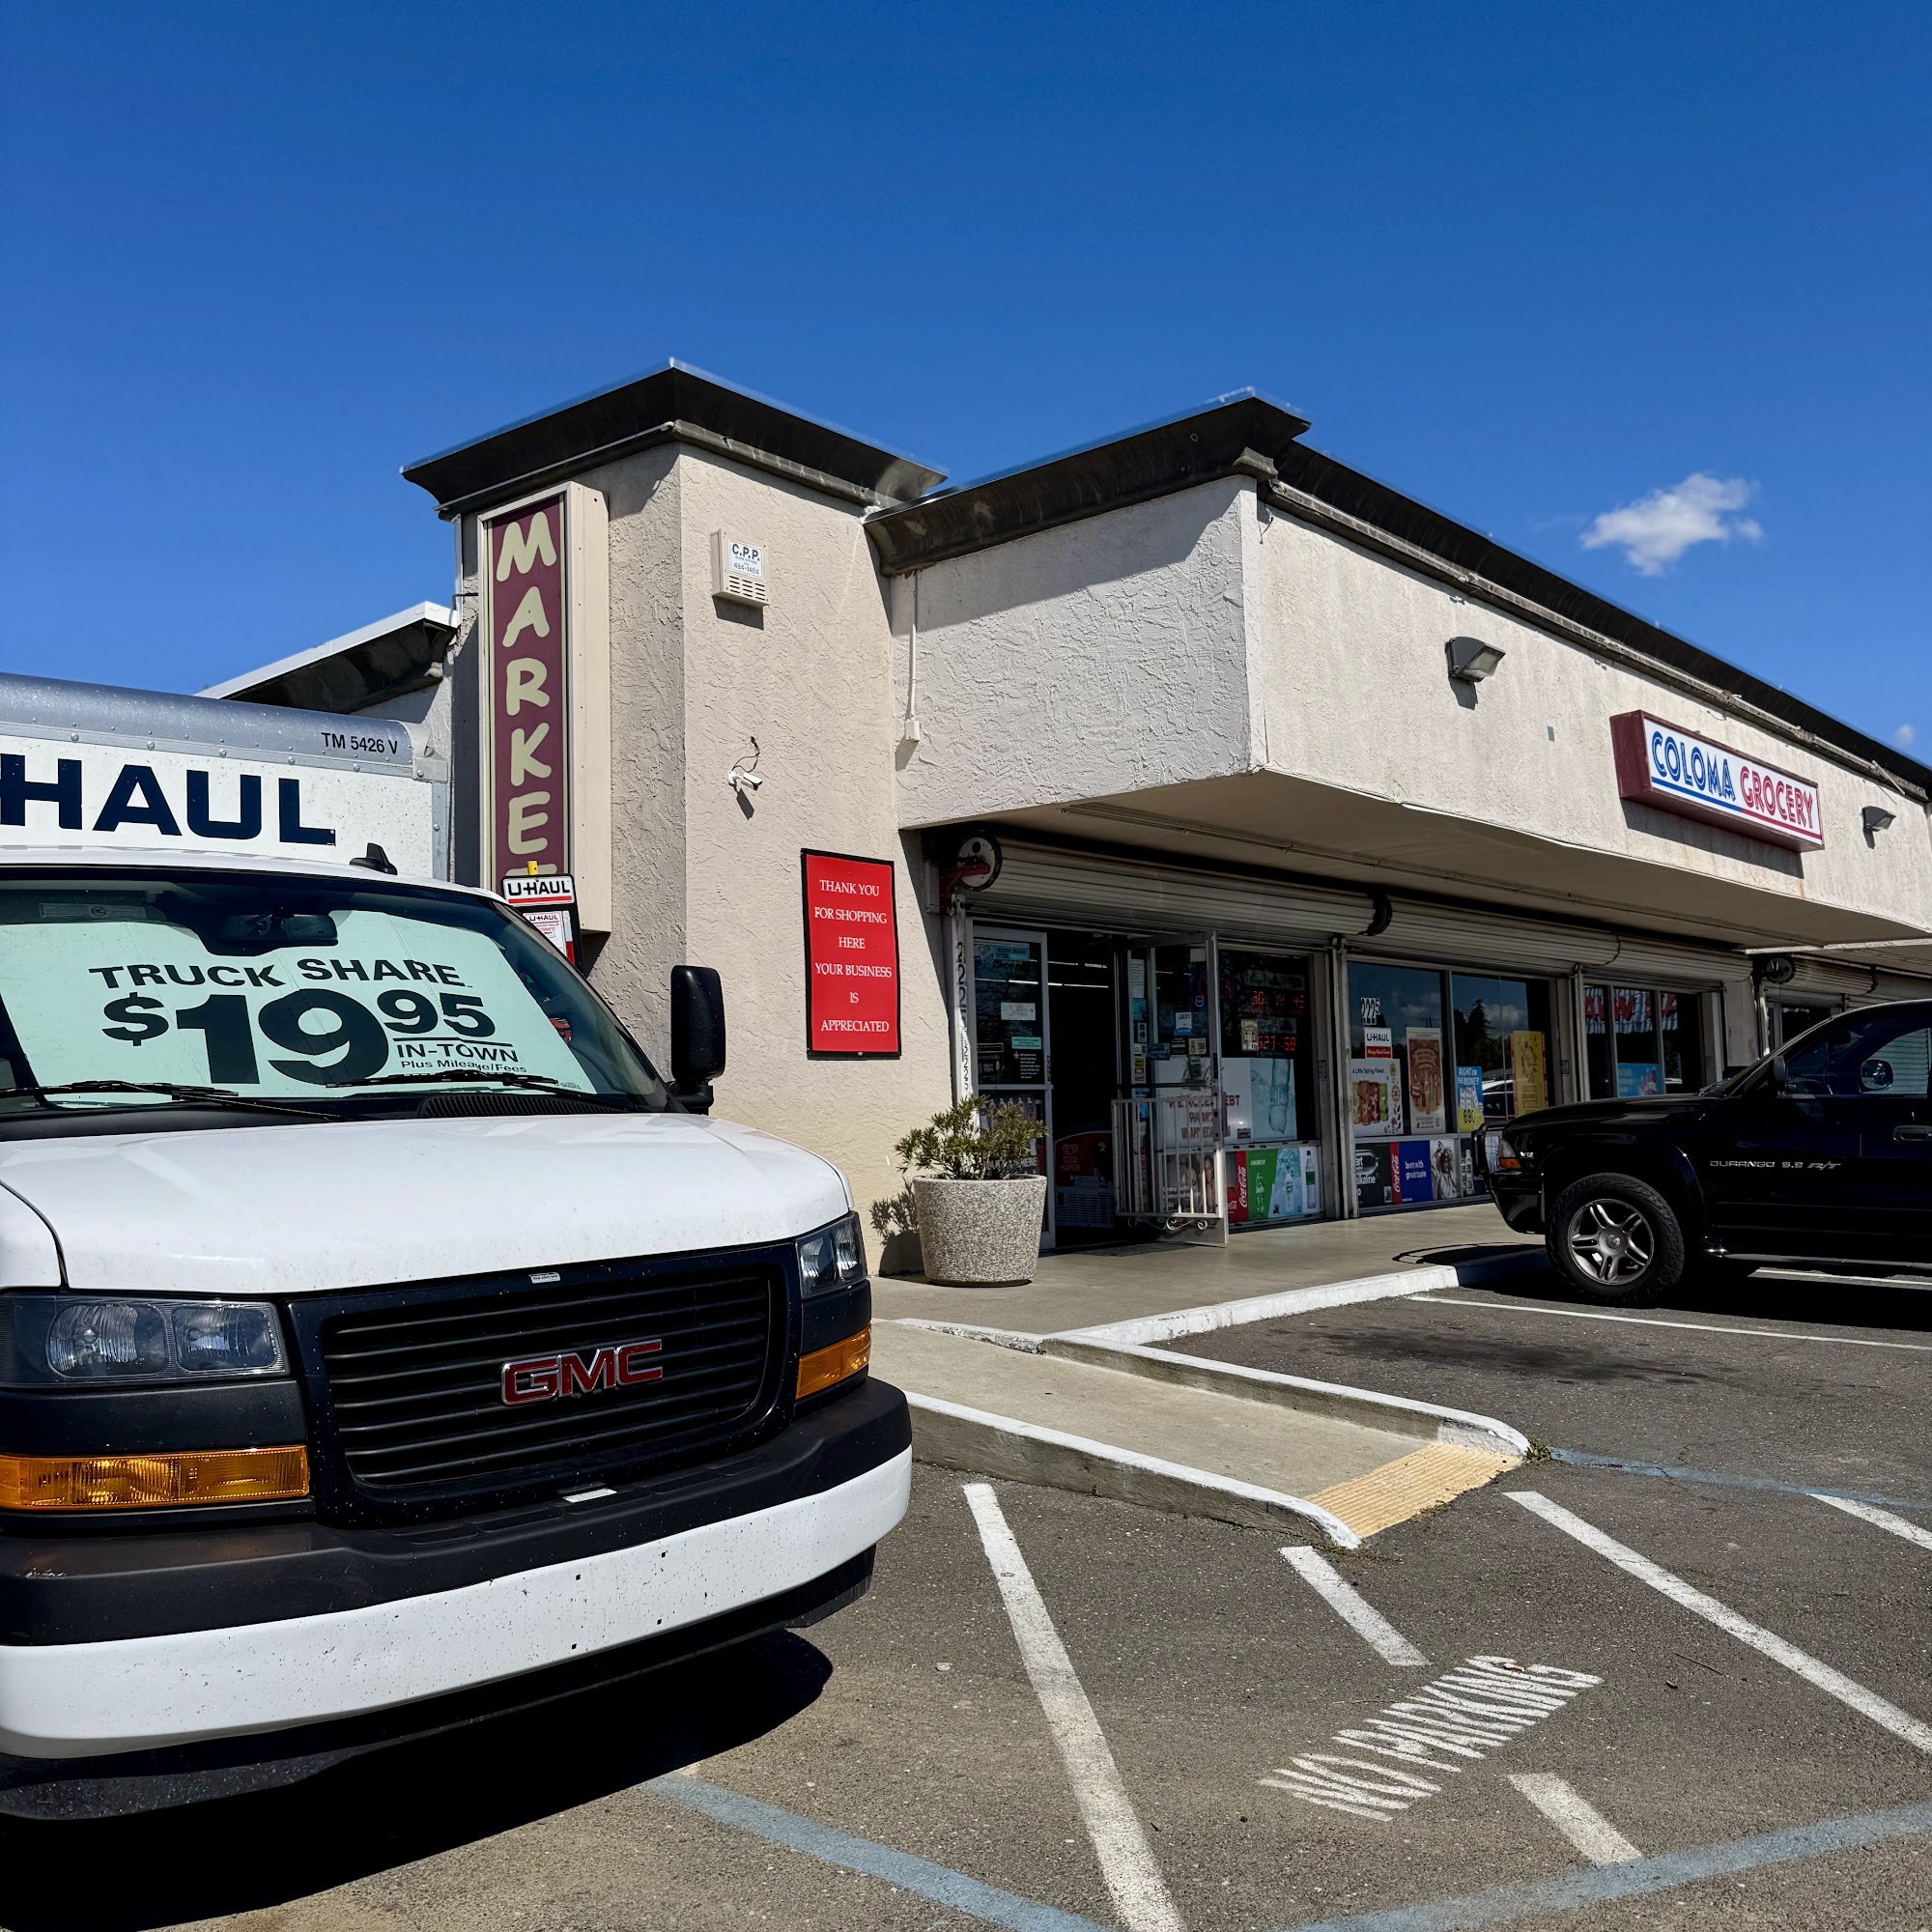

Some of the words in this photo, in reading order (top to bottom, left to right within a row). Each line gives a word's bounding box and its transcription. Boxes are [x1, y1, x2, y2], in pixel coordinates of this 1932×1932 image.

[732, 543, 760, 562] C.P.P.
[321, 732, 346, 749] TM
[351, 736, 384, 753] 5426
[387, 740, 398, 754] V
[1652, 731, 1737, 802] COLOMA
[1740, 766, 1813, 829] GROCERY
[507, 880, 570, 896] U-HAUL
[820, 880, 857, 895] THANK
[859, 884, 879, 896] YOU
[814, 907, 835, 920] FOR
[836, 909, 887, 923] SHOPPING
[838, 937, 865, 950] HERE
[88, 964, 286, 990] TRUCK
[297, 958, 466, 987] SHARE
[815, 963, 843, 976] YOUR
[845, 965, 892, 978] BUSINESS
[850, 992, 859, 1004] IS
[821, 1020, 889, 1033] APPRECIATED
[1367, 1034, 1389, 1042] U-HAUL
[396, 1043, 519, 1063] IN-TOWN
[501, 1339, 664, 1406] GMC
